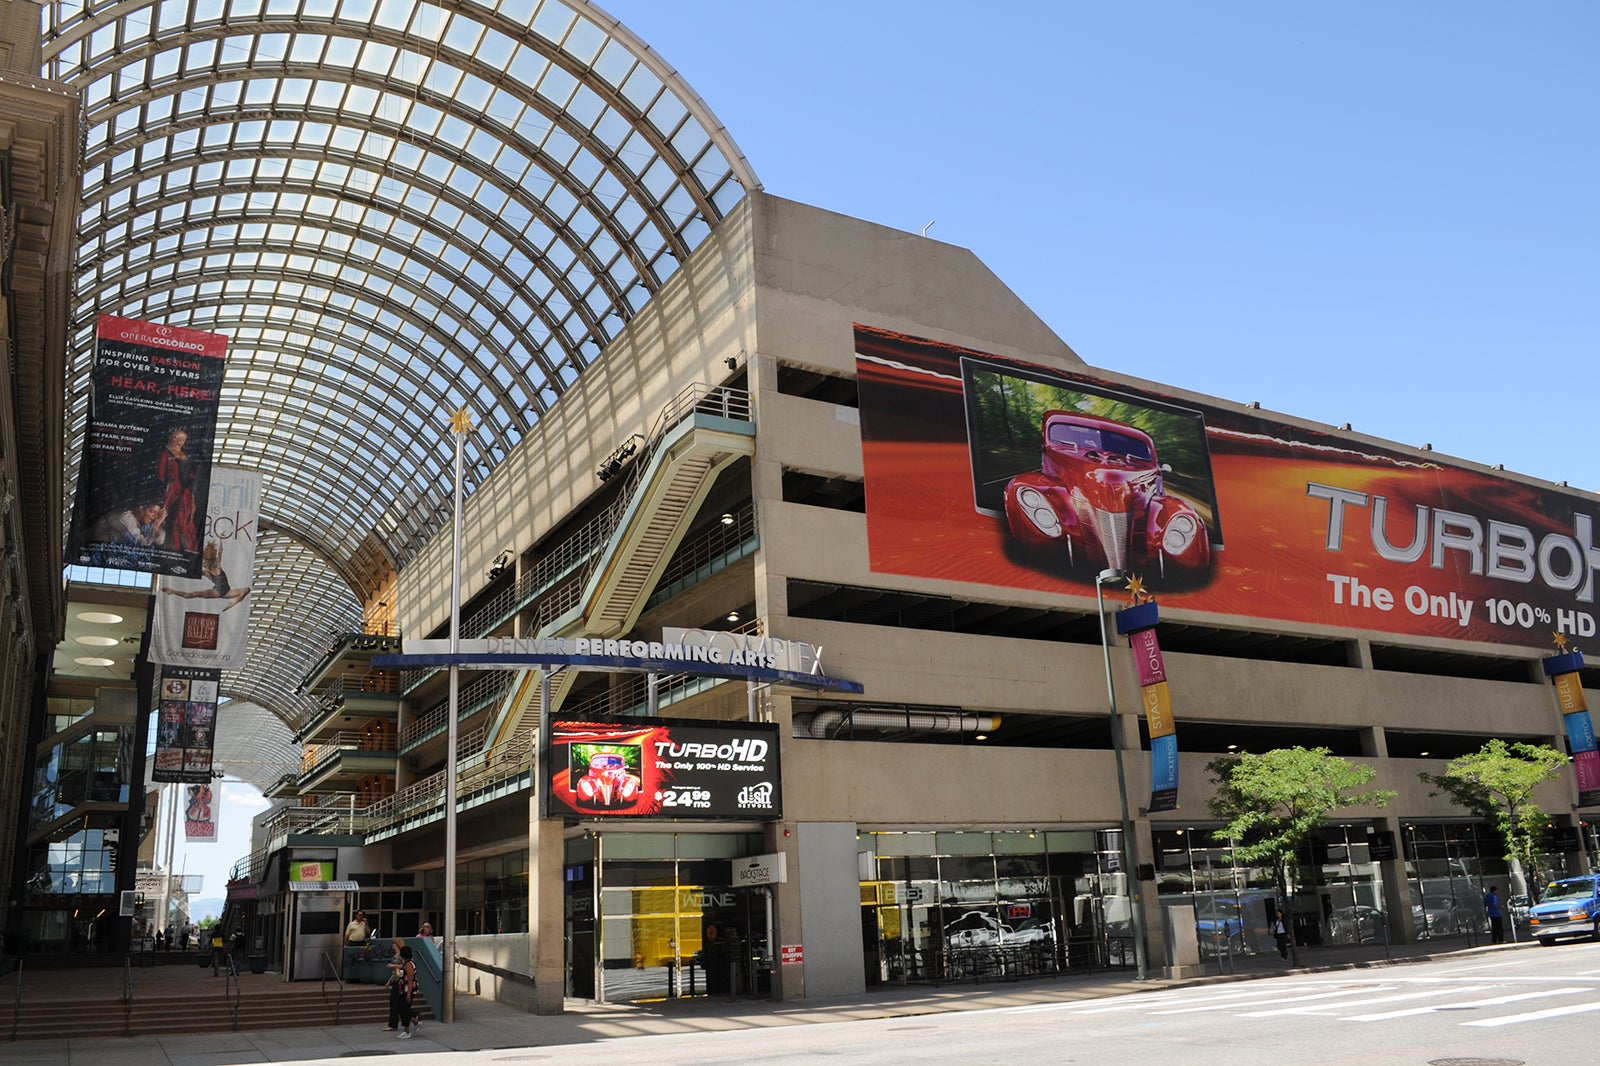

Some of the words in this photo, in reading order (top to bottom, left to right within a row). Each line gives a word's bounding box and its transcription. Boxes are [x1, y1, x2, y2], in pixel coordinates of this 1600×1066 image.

[100, 358, 120, 367] FOR
[123, 361, 150, 372] OVER
[153, 366, 166, 375] 25
[169, 369, 200, 380] YEARS
[101, 349, 149, 362] INSPIRING
[151, 355, 202, 370] PASSION
[111, 375, 161, 395] HEAR,
[167, 384, 216, 402] HERE!
[174, 402, 194, 411] HOUSE
[118, 424, 150, 433] BUTTERFLY
[1326, 573, 1395, 612] The
[1404, 585, 1474, 628] Only
[1485, 598, 1551, 629] 100%
[1556, 607, 1597, 638] HD
[186, 625, 215, 640] BALLET
[487, 636, 566, 656] DENVER
[575, 637, 724, 664] PERFORMING
[731, 648, 777, 669] ARTS
[1142, 630, 1163, 676] JONES
[178, 669, 211, 678] UNITED
[1559, 679, 1575, 710] BUELL
[1148, 685, 1163, 730] STAGE
[654, 738, 769, 762] TURBOHD
[654, 761, 672, 769] The
[673, 761, 694, 771] Only
[717, 763, 731, 771] HD
[732, 763, 764, 772] Service
[737, 781, 773, 804] dish
[693, 801, 711, 809] mo
[740, 867, 770, 880] BACKSTAGE
[682, 893, 737, 908] WINE
[1009, 906, 1030, 918] OPEN
